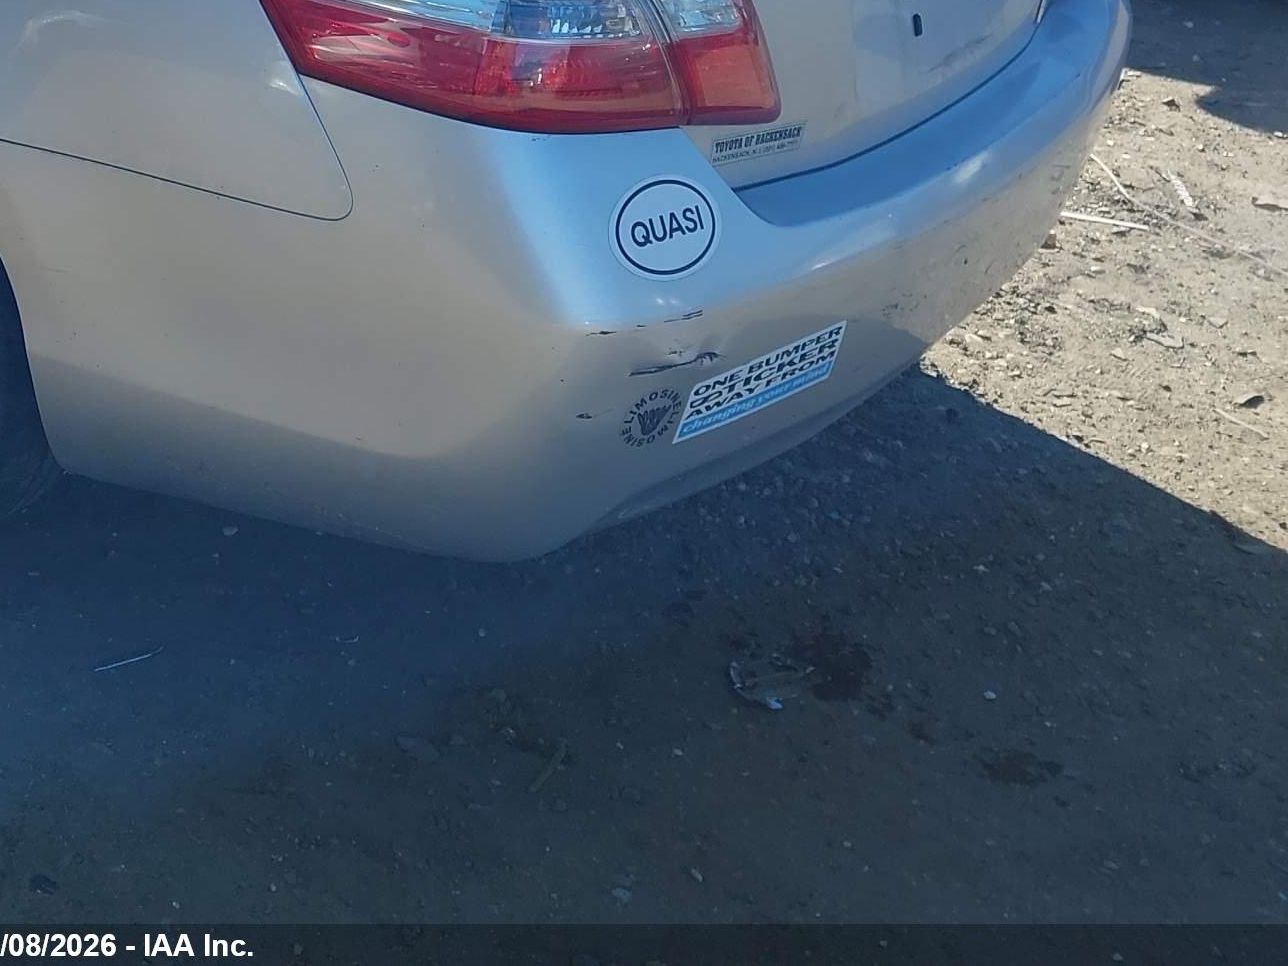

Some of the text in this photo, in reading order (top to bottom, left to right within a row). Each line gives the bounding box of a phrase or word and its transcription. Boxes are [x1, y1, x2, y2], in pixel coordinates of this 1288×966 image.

[715, 138, 743, 153] TOYOTA
[744, 135, 755, 148] OF
[755, 126, 802, 146] HACKENSACK
[631, 205, 705, 248] QUASI
[694, 326, 843, 397] ONE BUMPER
[685, 349, 836, 420] AWAY FROM
[682, 398, 756, 433] changing
